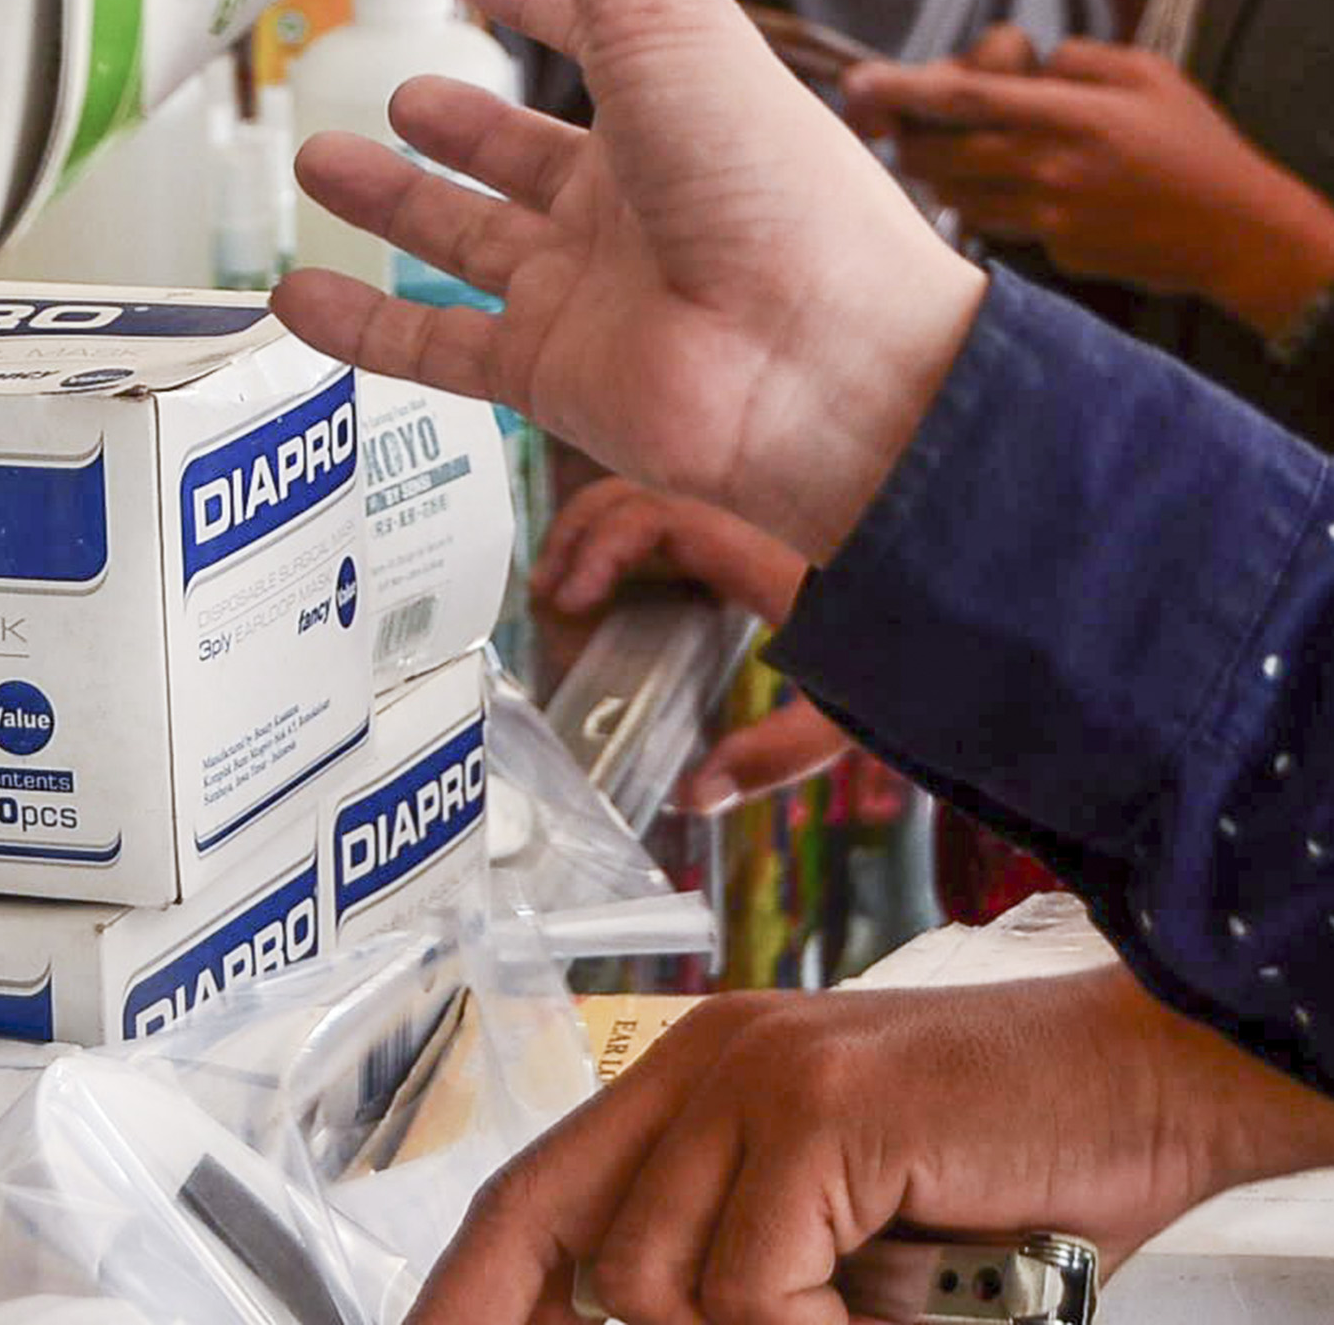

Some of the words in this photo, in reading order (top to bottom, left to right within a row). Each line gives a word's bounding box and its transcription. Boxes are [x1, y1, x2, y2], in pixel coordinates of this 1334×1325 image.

[192, 402, 355, 546] DIAPRO
[198, 632, 232, 661] 3ply
[297, 596, 332, 635] fancy
[341, 745, 485, 885] DIAPRO
